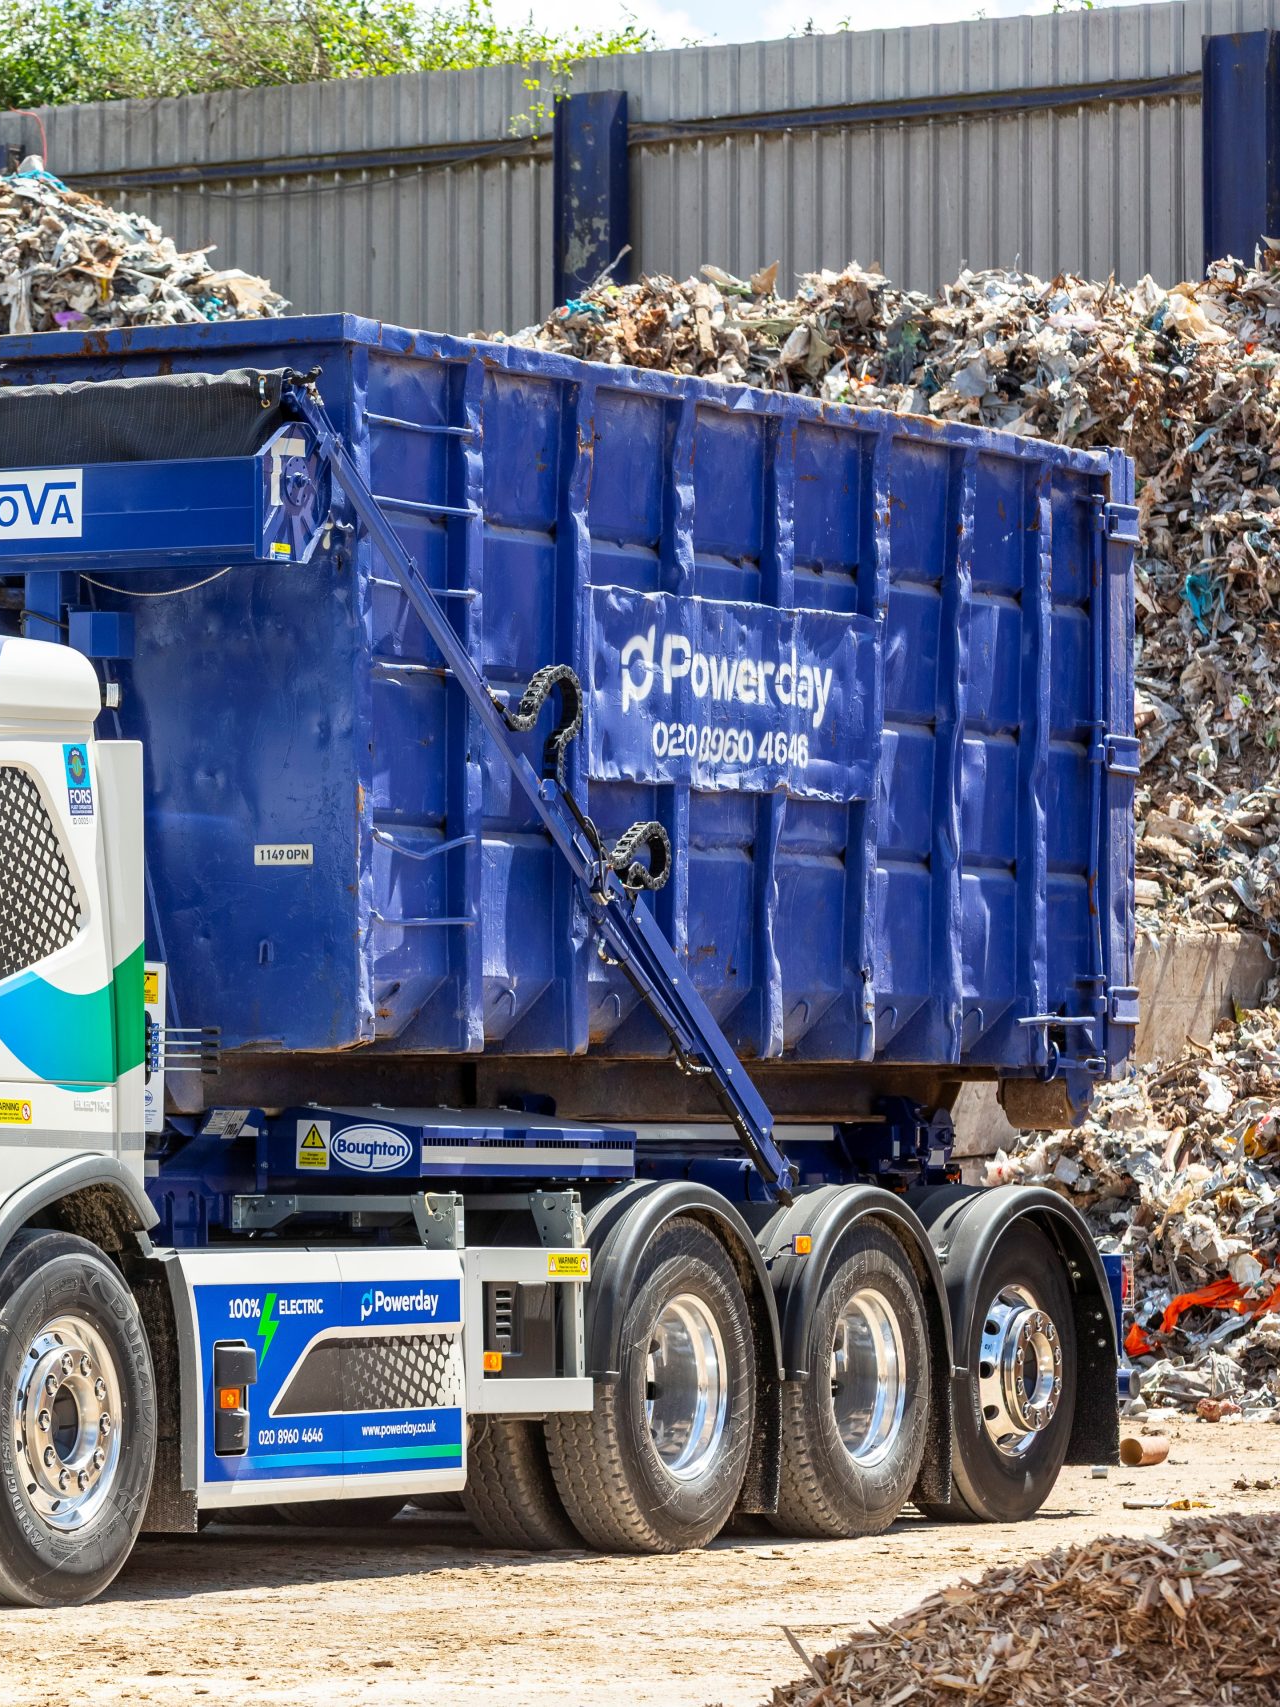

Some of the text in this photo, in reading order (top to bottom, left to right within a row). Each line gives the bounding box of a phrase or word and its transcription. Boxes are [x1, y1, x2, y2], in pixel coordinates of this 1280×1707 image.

[662, 633, 833, 728] Powerday
[652, 722, 809, 768] 020 8960 4646
[69, 789, 92, 804] FORS
[260, 849, 284, 861] 1149
[336, 1138, 406, 1160] Boughton
[558, 1256, 579, 1264] WARNING
[228, 1298, 324, 1318] 100% ELECTRIC
[375, 1289, 439, 1317] Powerday
[258, 1427, 324, 1445] 020 8960 4646
[361, 1420, 436, 1438] www.powerday.co.uk
